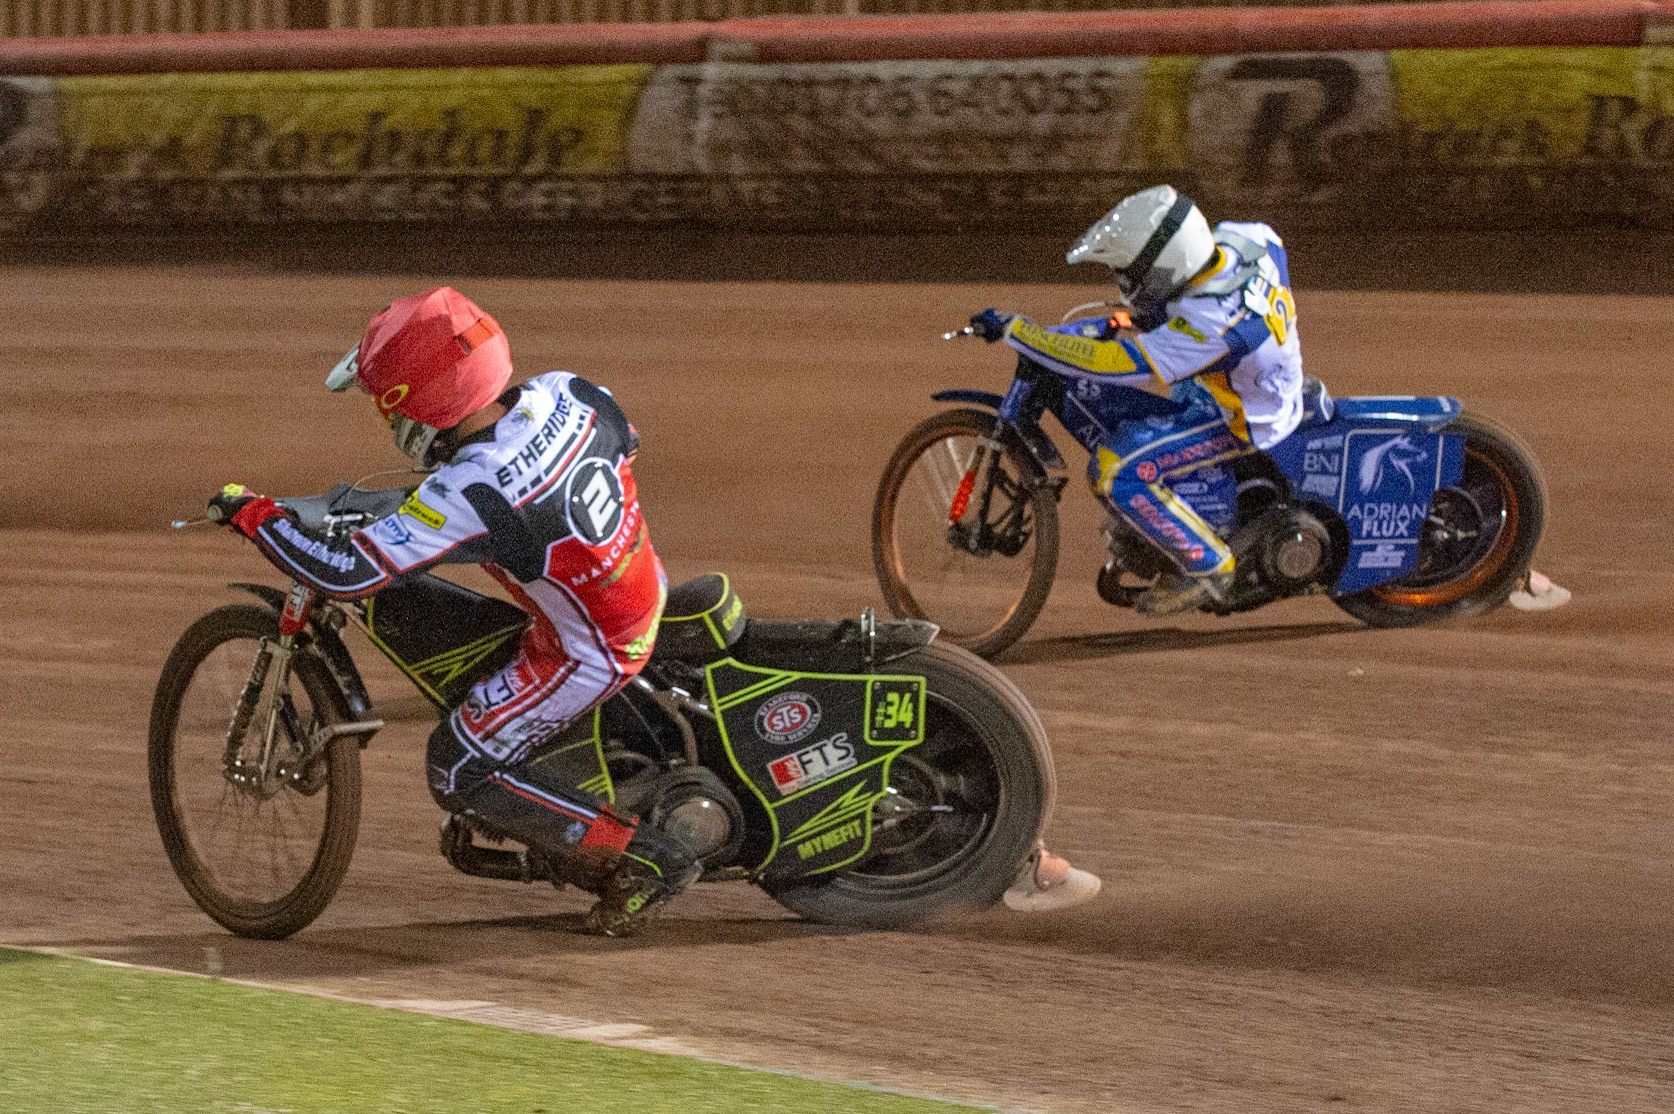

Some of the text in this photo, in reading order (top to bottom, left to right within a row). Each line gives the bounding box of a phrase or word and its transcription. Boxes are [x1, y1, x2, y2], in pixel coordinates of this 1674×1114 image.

[1347, 503, 1427, 521] ADRIAN
[1361, 518, 1409, 538] FLUX
[771, 705, 802, 732] STS
[797, 733, 850, 775] FTS
